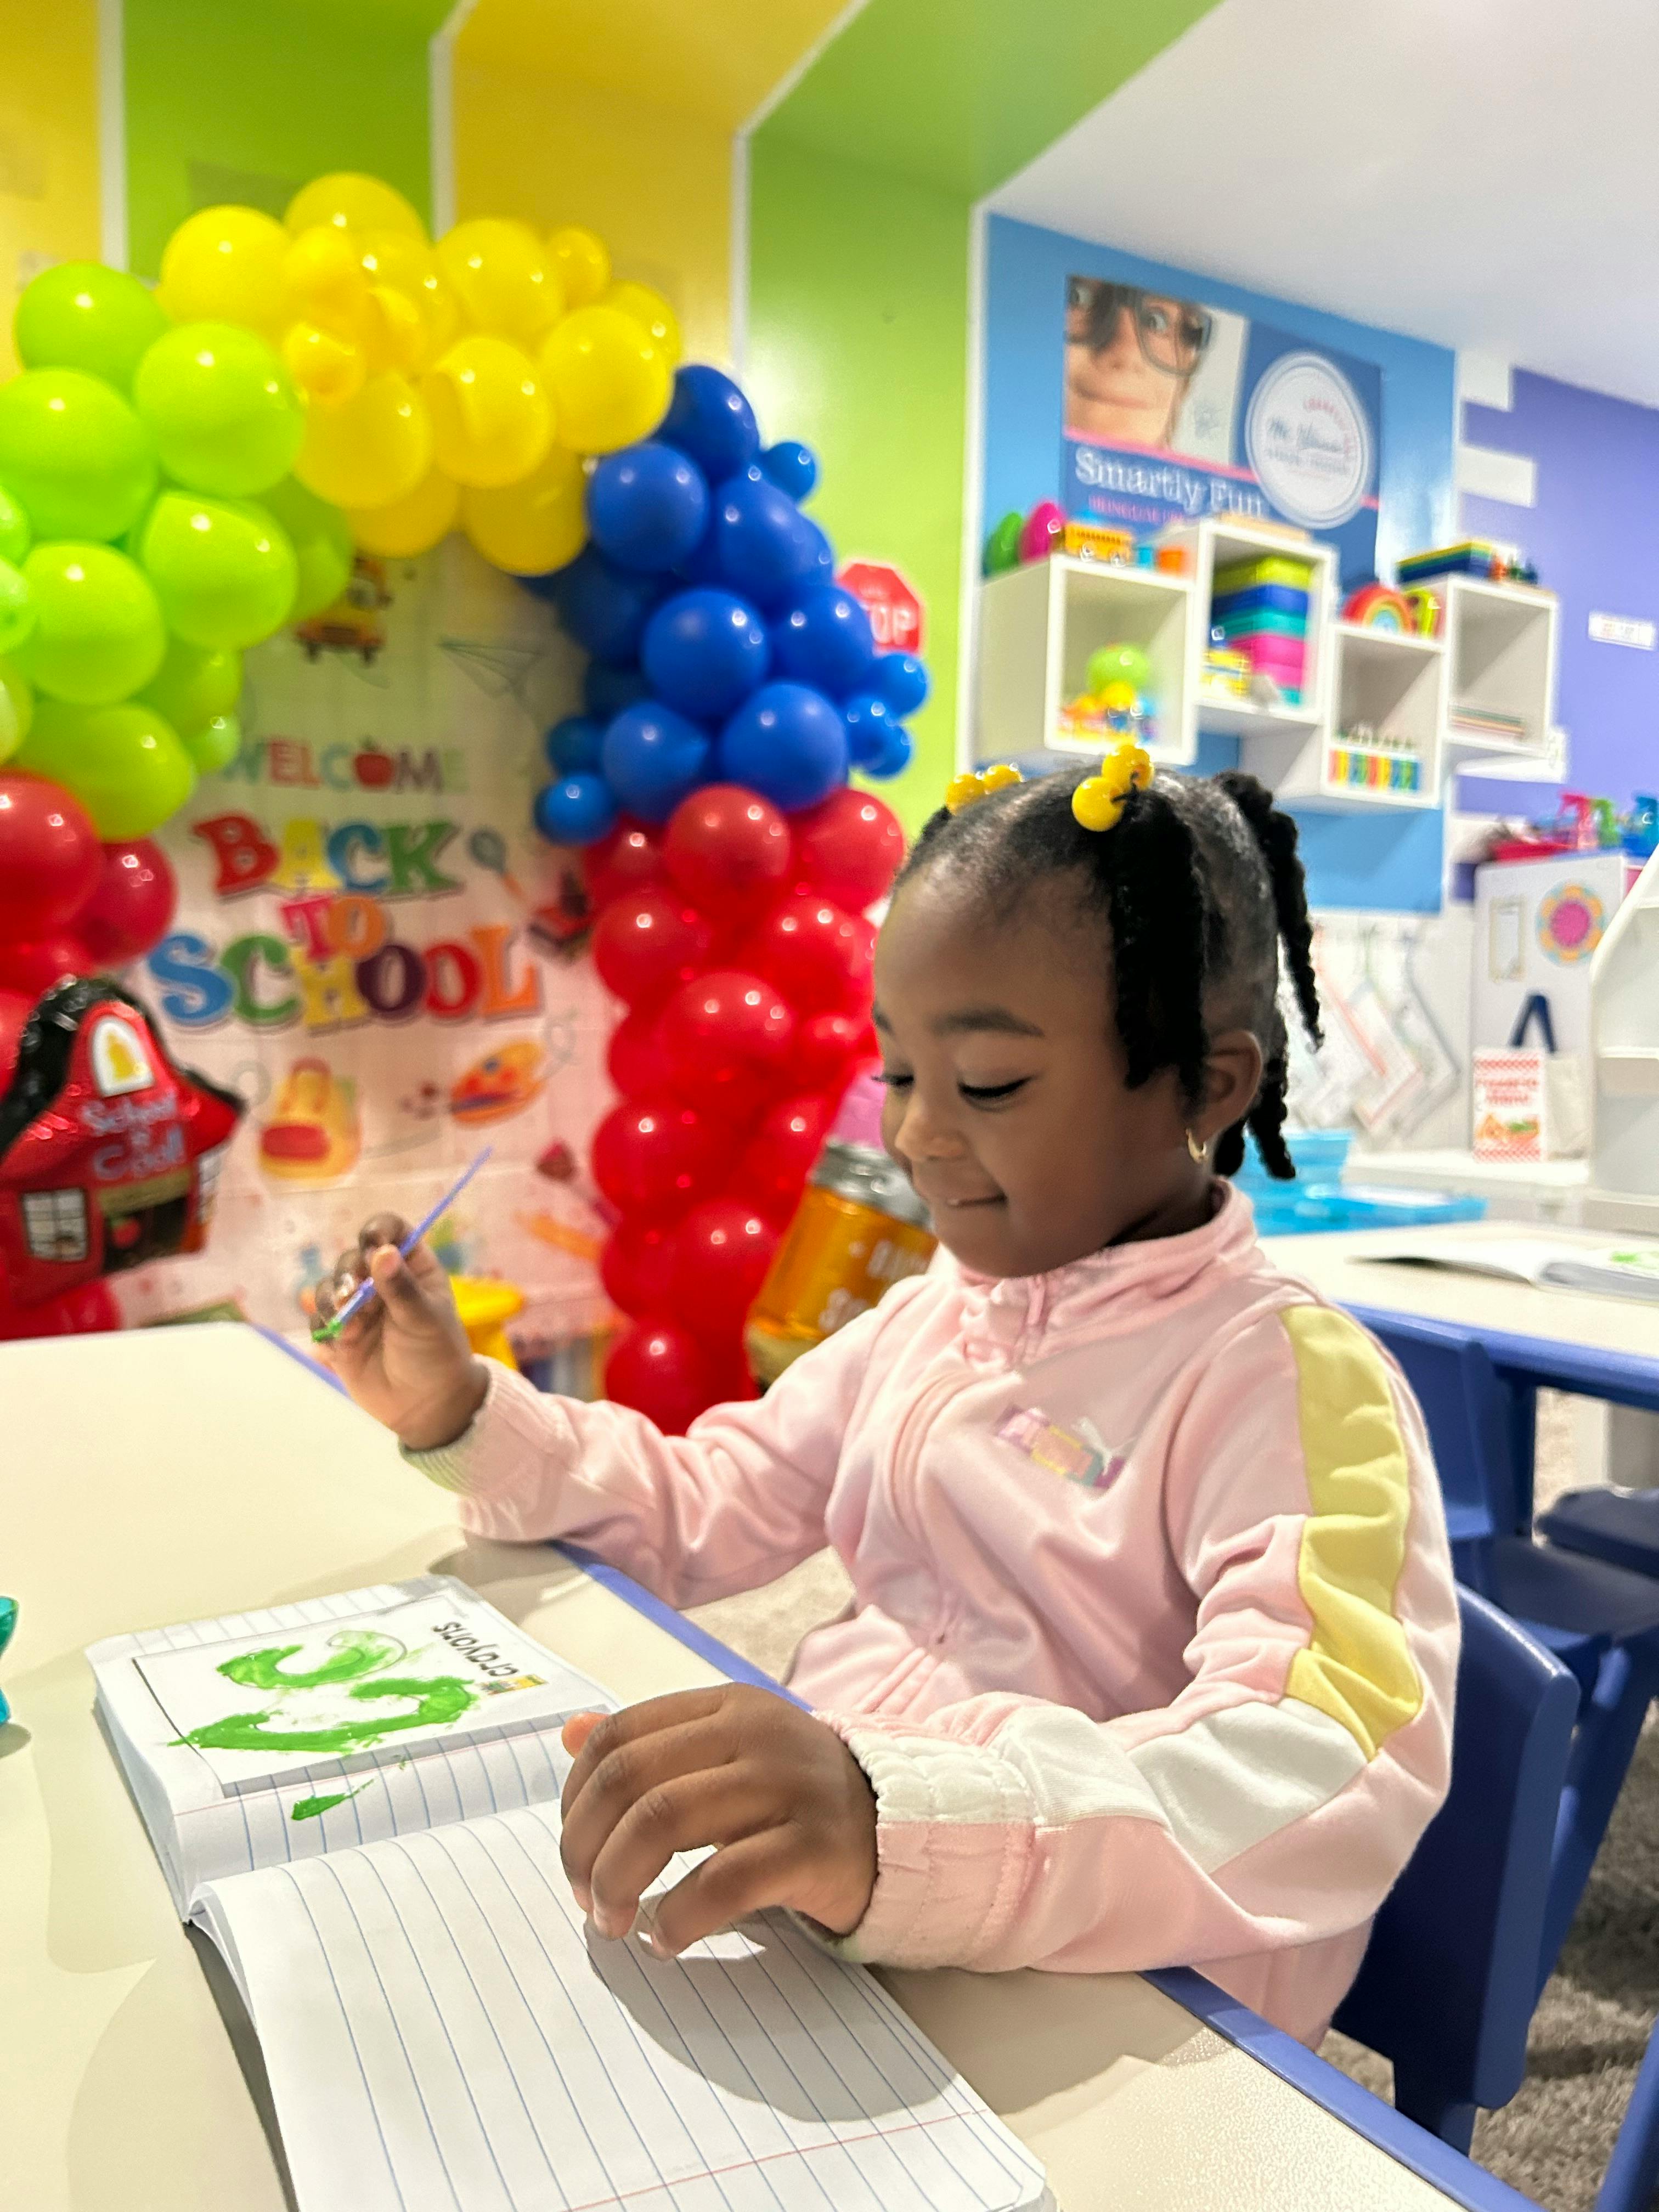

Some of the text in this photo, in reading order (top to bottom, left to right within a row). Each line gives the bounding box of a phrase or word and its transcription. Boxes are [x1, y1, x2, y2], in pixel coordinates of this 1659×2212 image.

[1076, 446, 1204, 515] Smartly
[1210, 477, 1265, 517] Fun
[194, 810, 466, 899] BACK
[280, 893, 388, 962] TO
[147, 925, 542, 1035] SCHOOL
[431, 1621, 519, 1677] crayons
